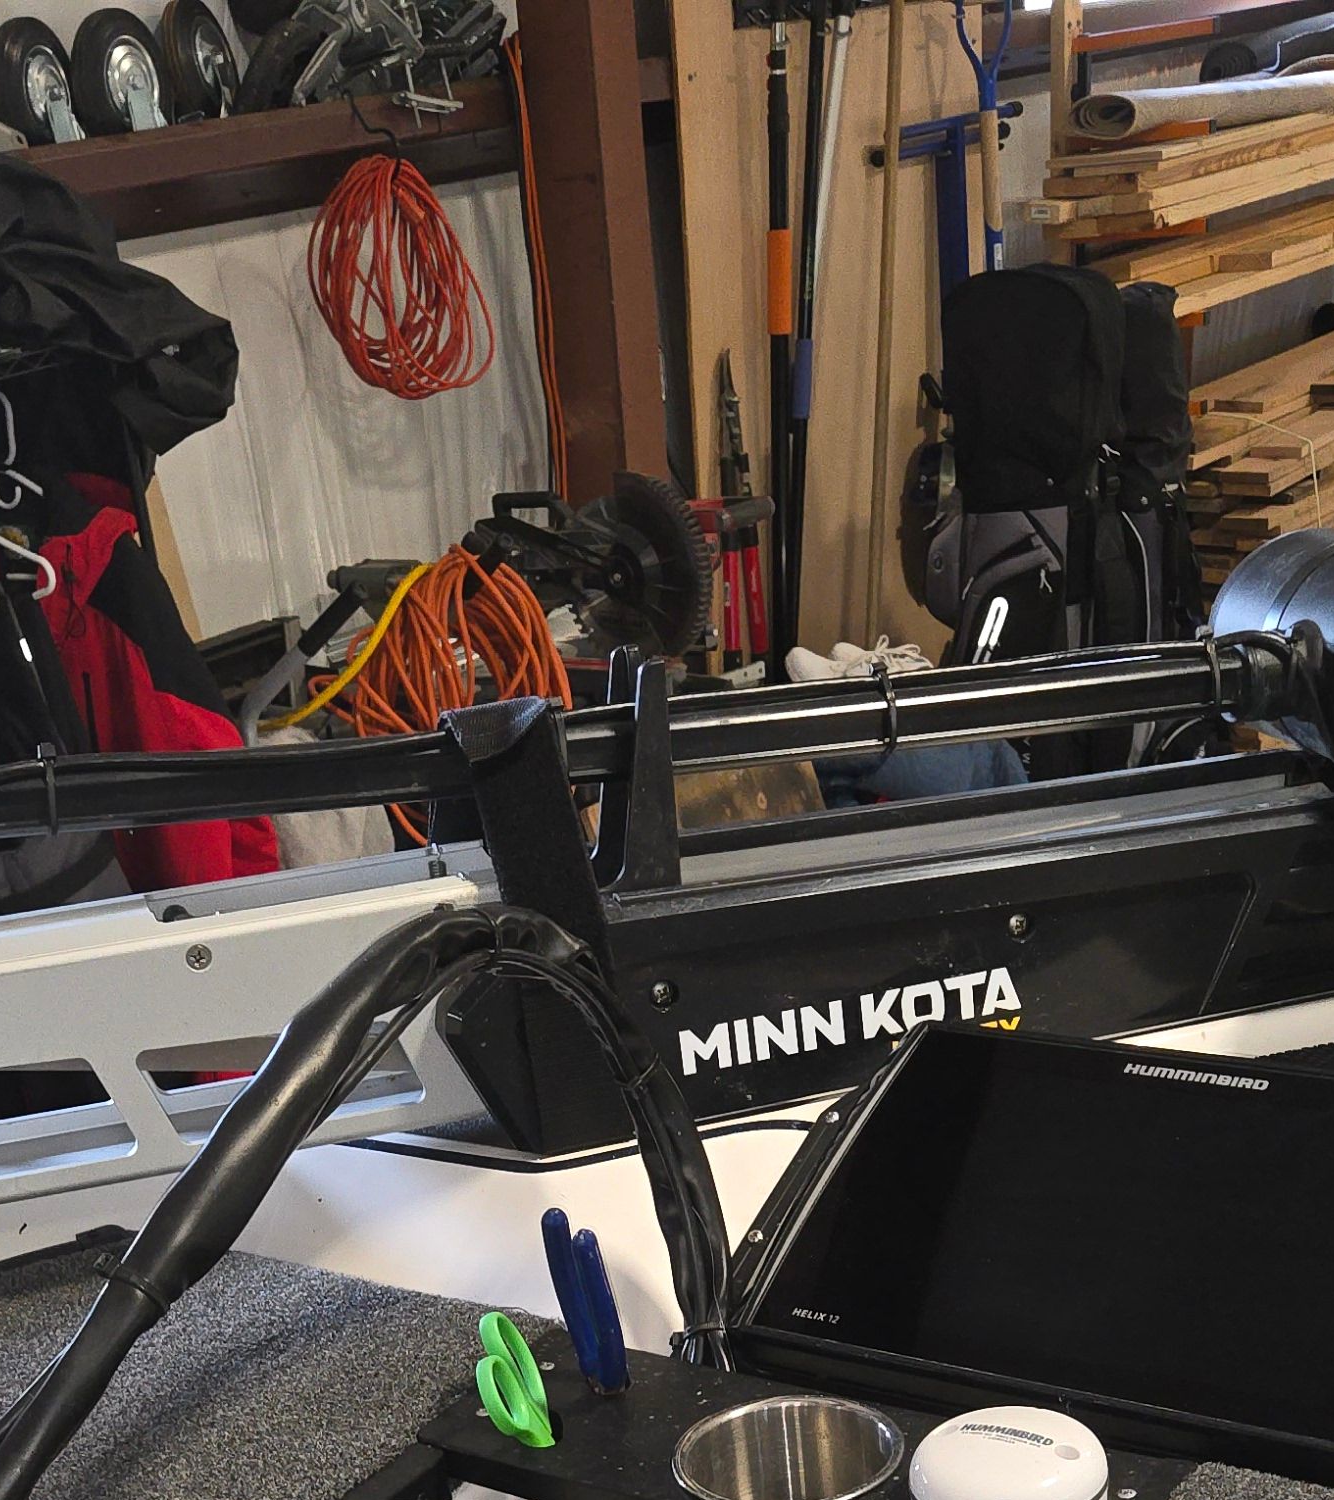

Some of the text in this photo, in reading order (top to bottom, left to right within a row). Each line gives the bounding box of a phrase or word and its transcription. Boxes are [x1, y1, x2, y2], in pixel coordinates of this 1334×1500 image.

[679, 1000, 846, 1076] MINN
[860, 967, 1022, 1039] KOTA
[1124, 1063, 1269, 1091] HUMMINBIRD
[792, 1307, 841, 1325] HELIX 12
[960, 1424, 1054, 1446] HUMMINBIRD
